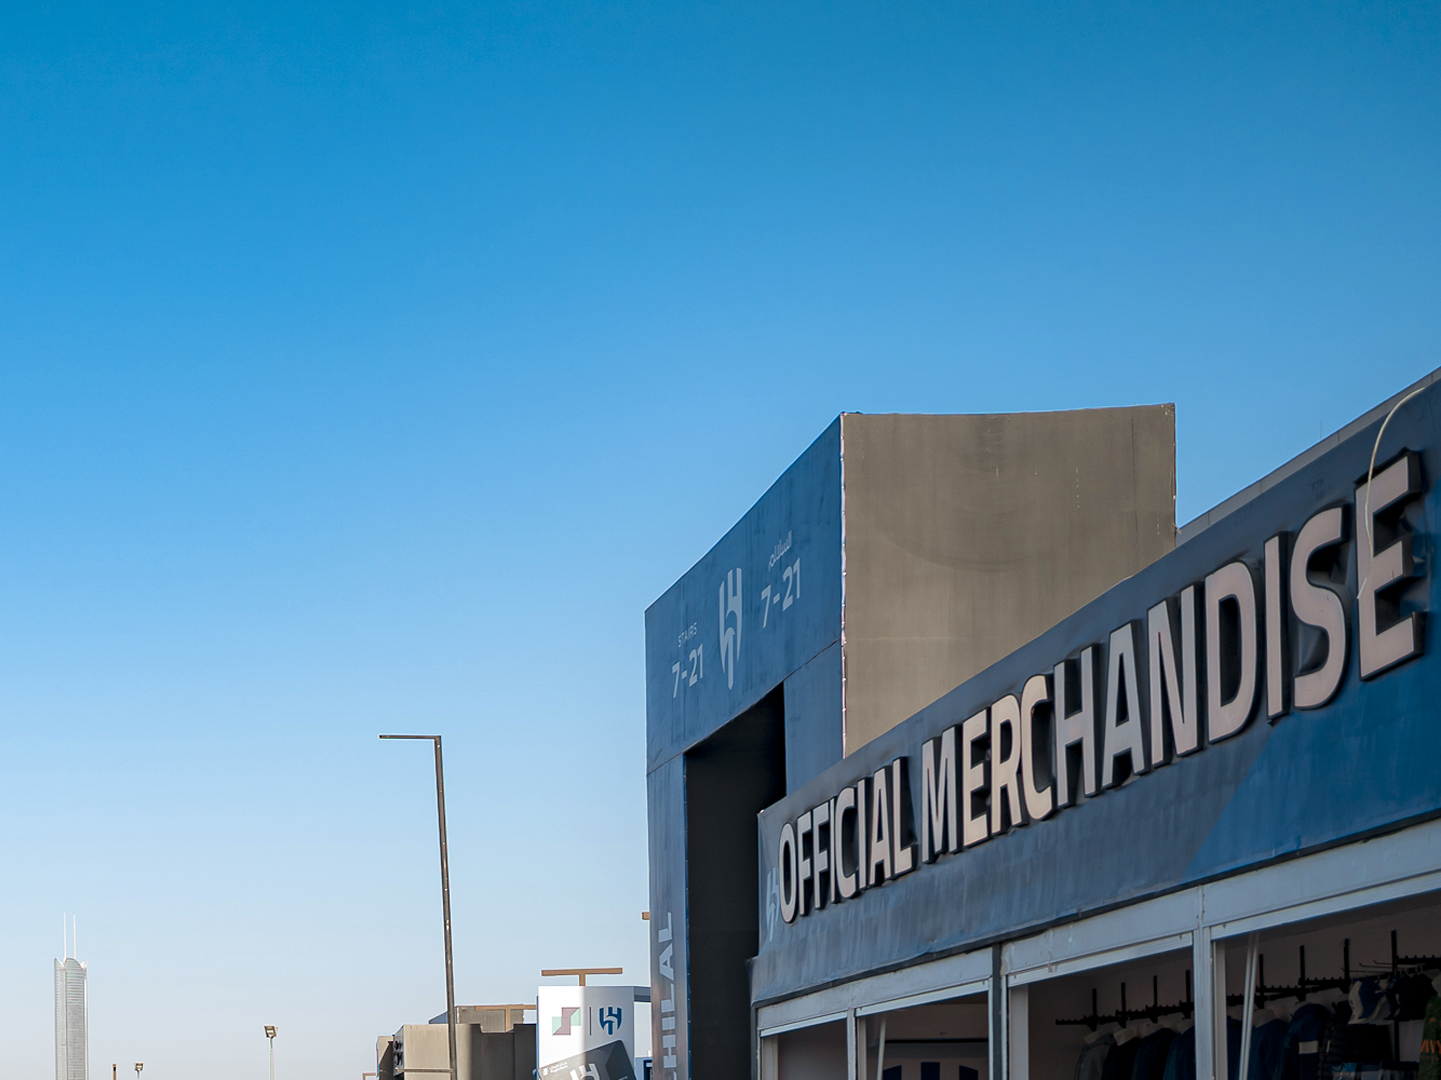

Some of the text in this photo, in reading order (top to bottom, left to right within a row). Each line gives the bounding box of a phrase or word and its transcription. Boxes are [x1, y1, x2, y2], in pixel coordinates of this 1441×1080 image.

[768, 530, 792, 572] السلالم
[761, 557, 801, 629] 7-21
[677, 621, 698, 648] STAIRS
[671, 643, 704, 699] 7-21
[777, 447, 1425, 924] OFFICIAL MERCHANDISE
